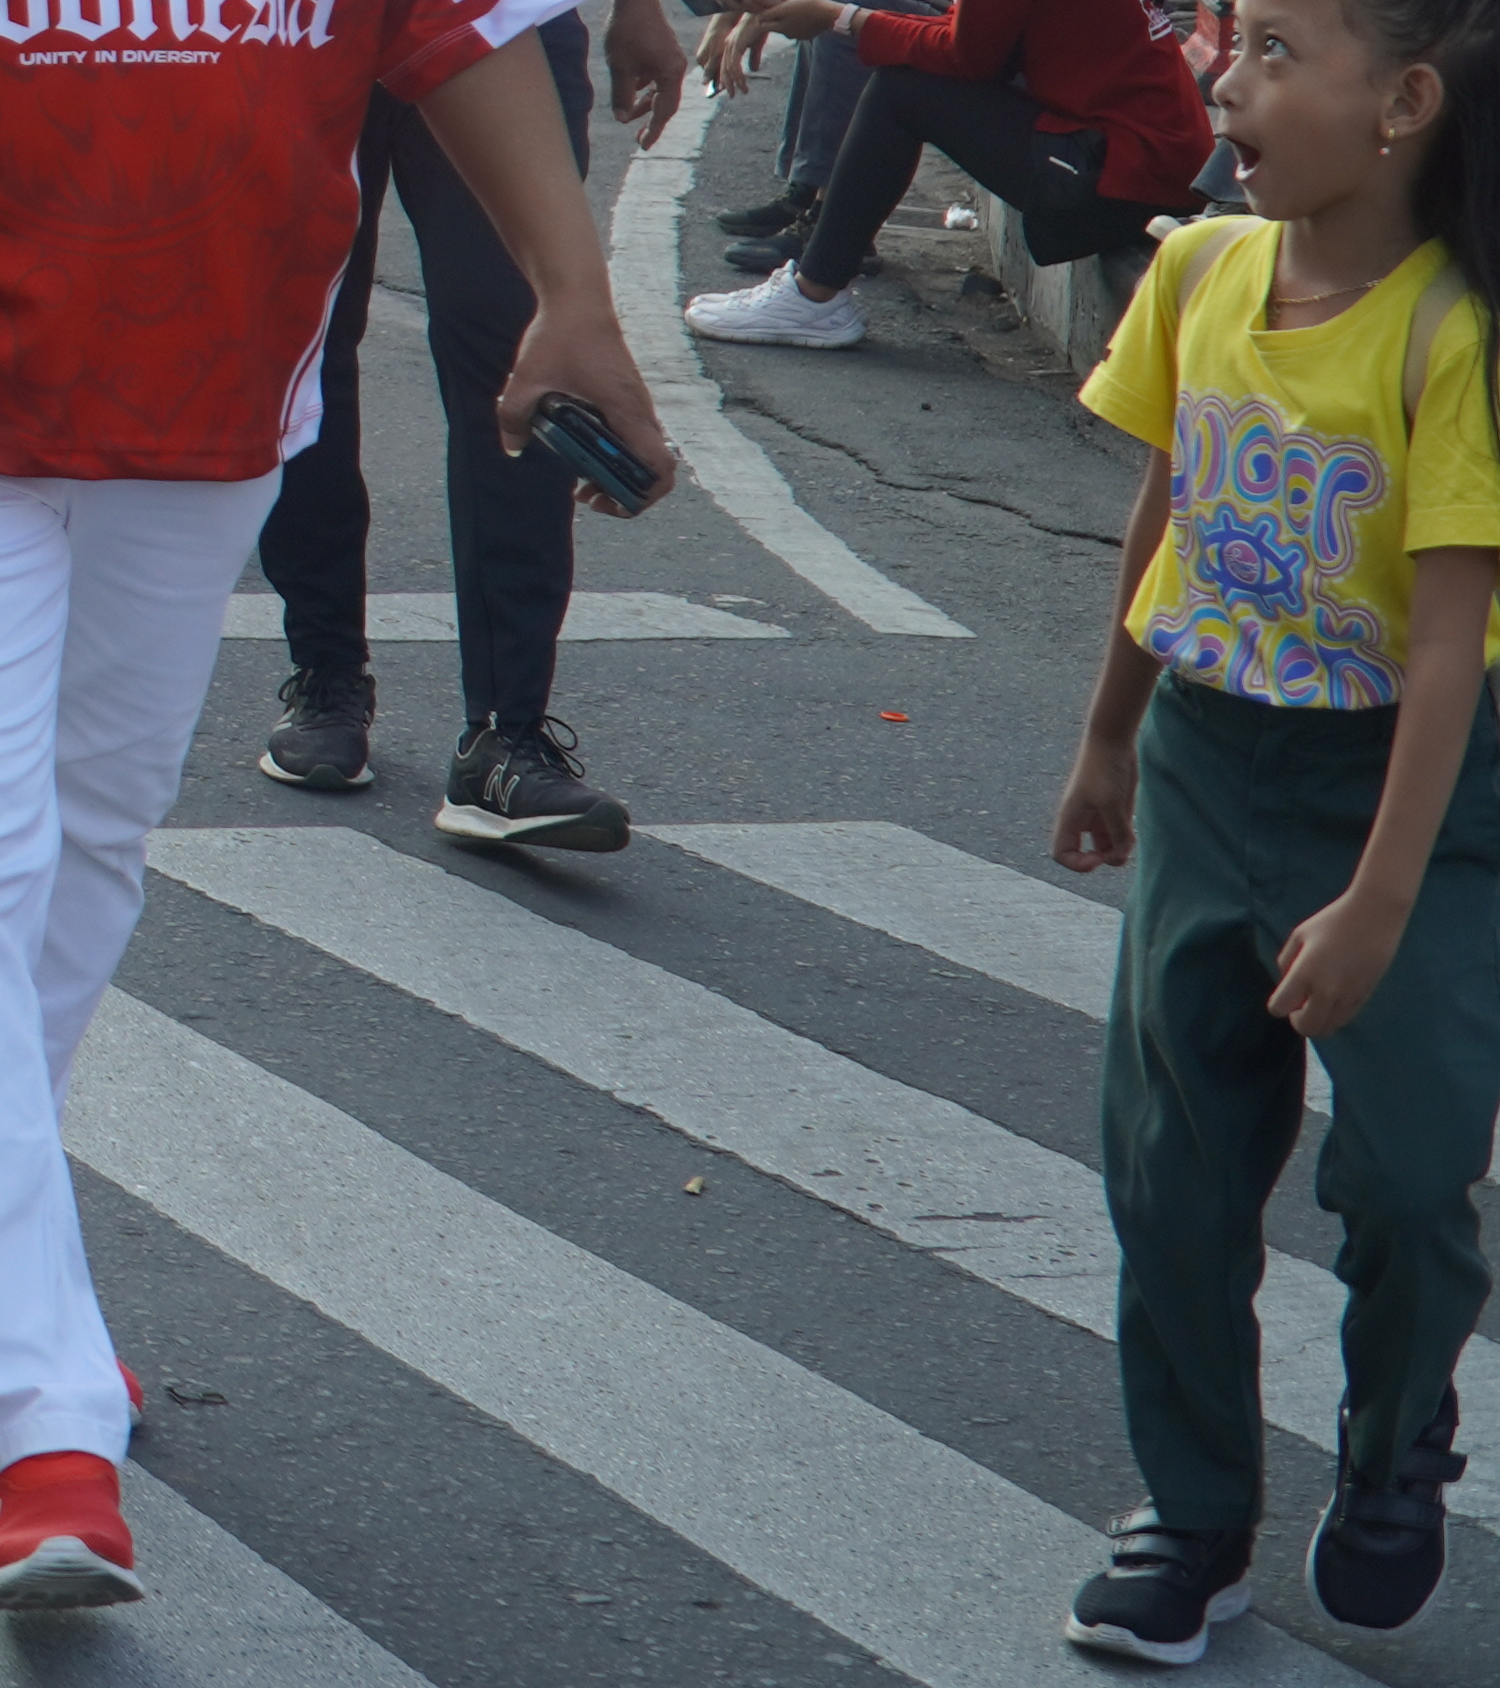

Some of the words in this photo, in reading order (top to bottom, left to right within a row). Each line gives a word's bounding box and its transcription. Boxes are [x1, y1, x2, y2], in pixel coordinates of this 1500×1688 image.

[20, 50, 86, 66] UNITY
[94, 50, 117, 64] IN
[122, 49, 222, 65] DIVERSITY
